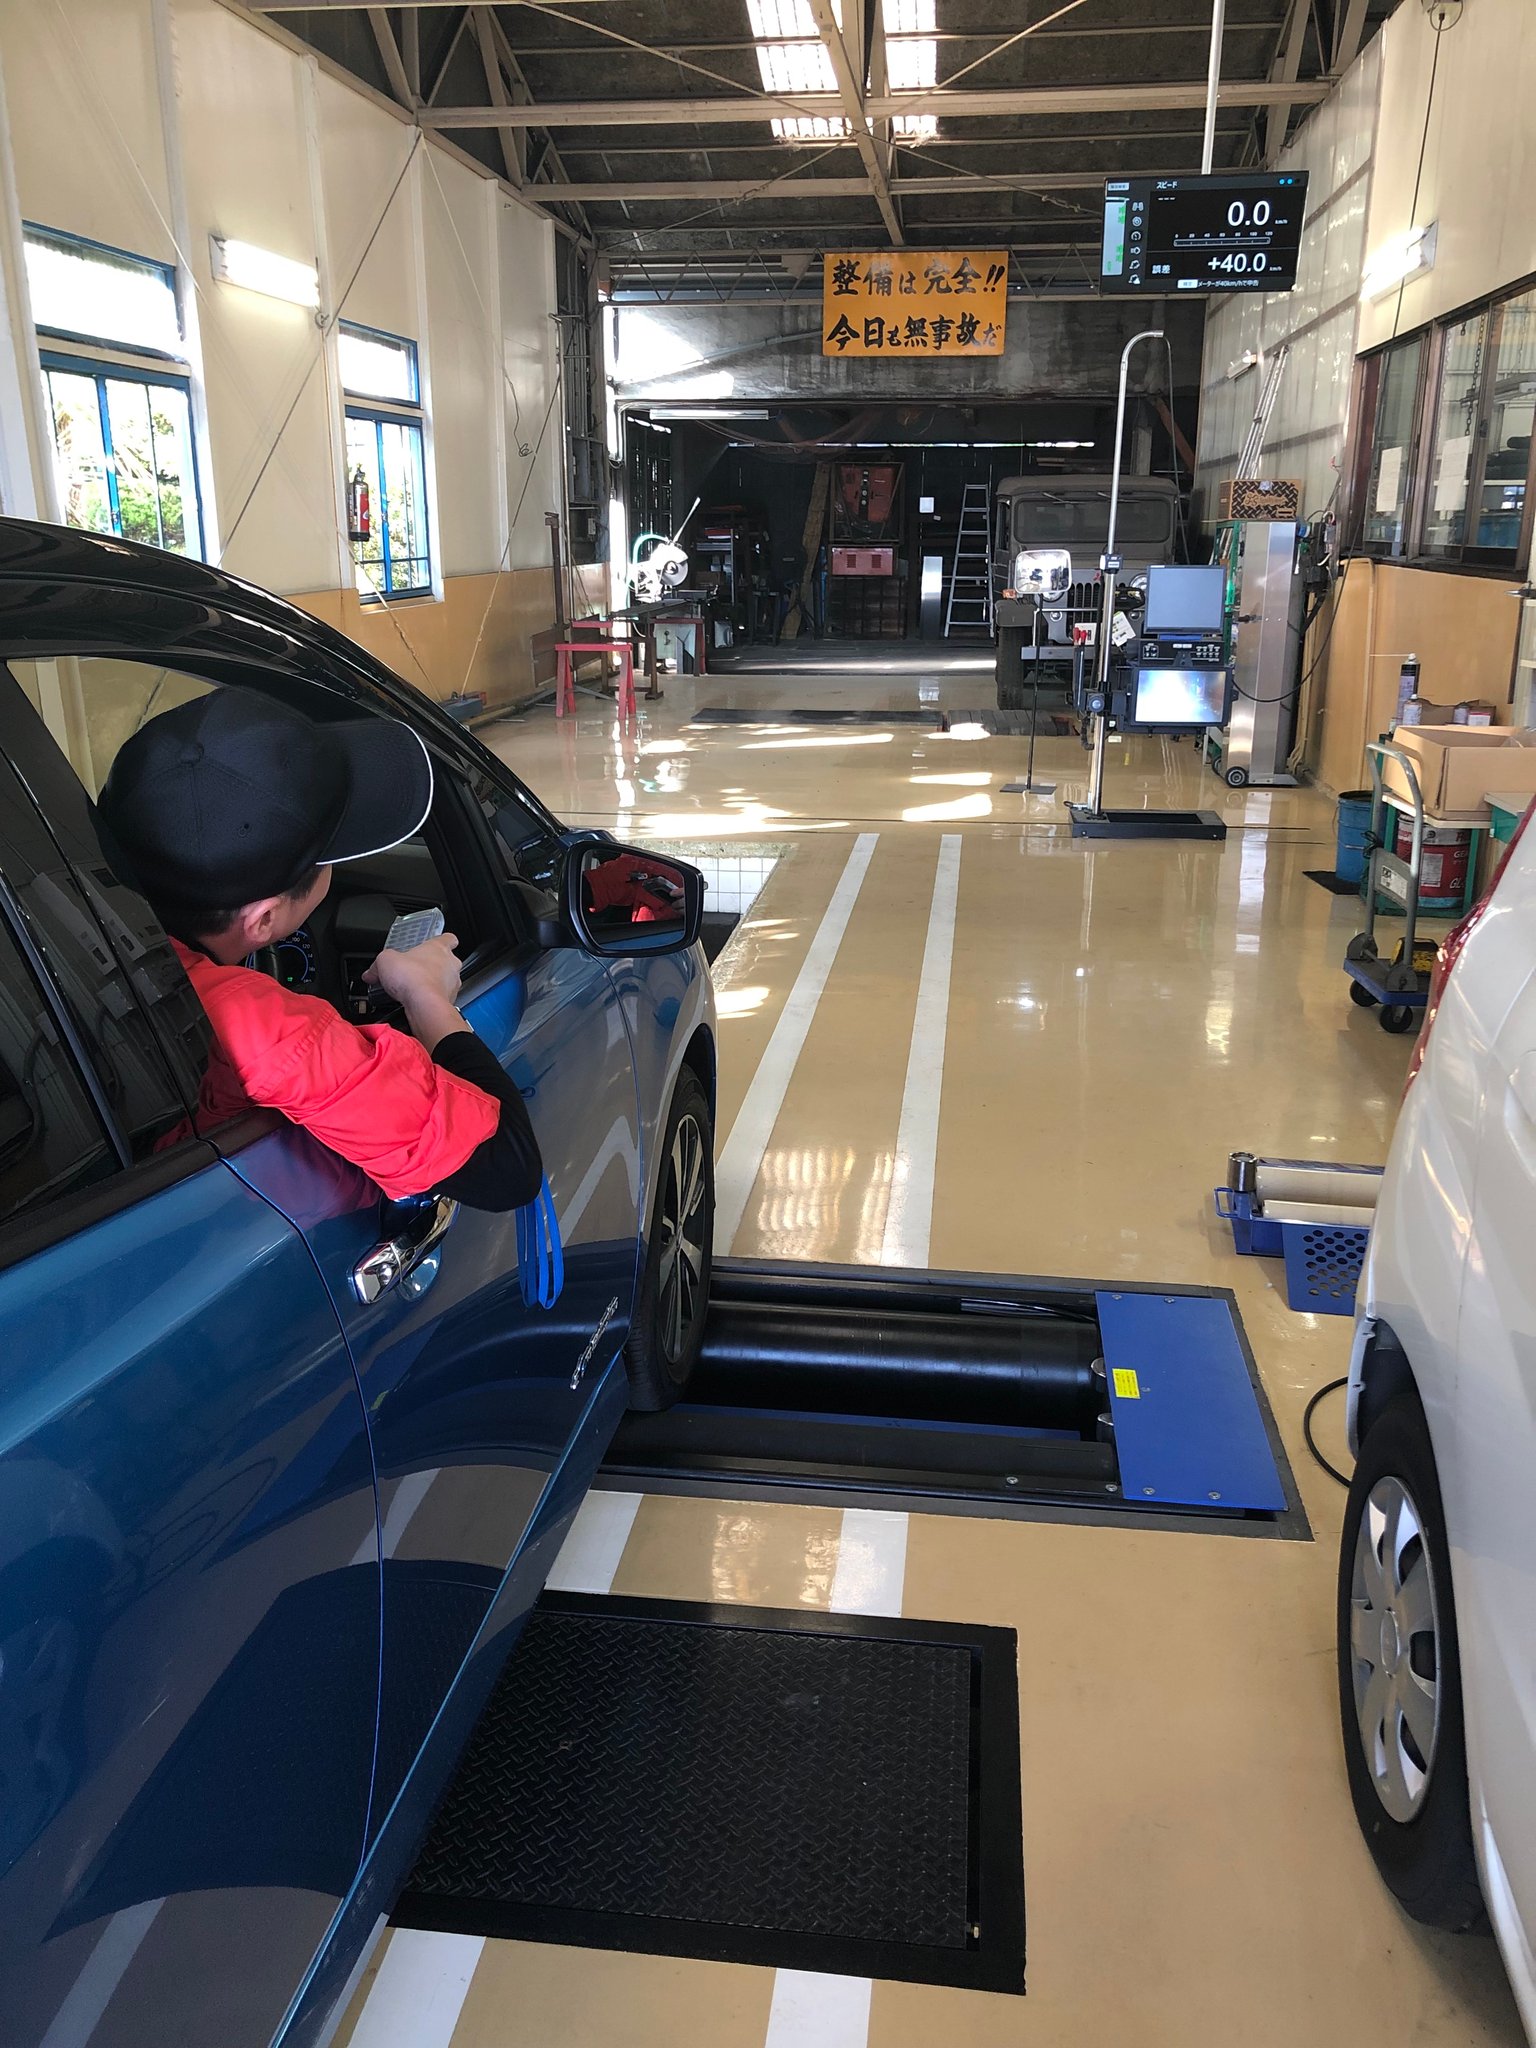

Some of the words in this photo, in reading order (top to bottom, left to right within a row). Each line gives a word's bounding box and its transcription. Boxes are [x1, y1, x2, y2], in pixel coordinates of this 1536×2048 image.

[1156, 181, 1178, 190] スピード
[1227, 200, 1271, 227] 0.0
[1207, 252, 1267, 273] +40.0
[826, 311, 1003, 352] 今日も無事故だ
